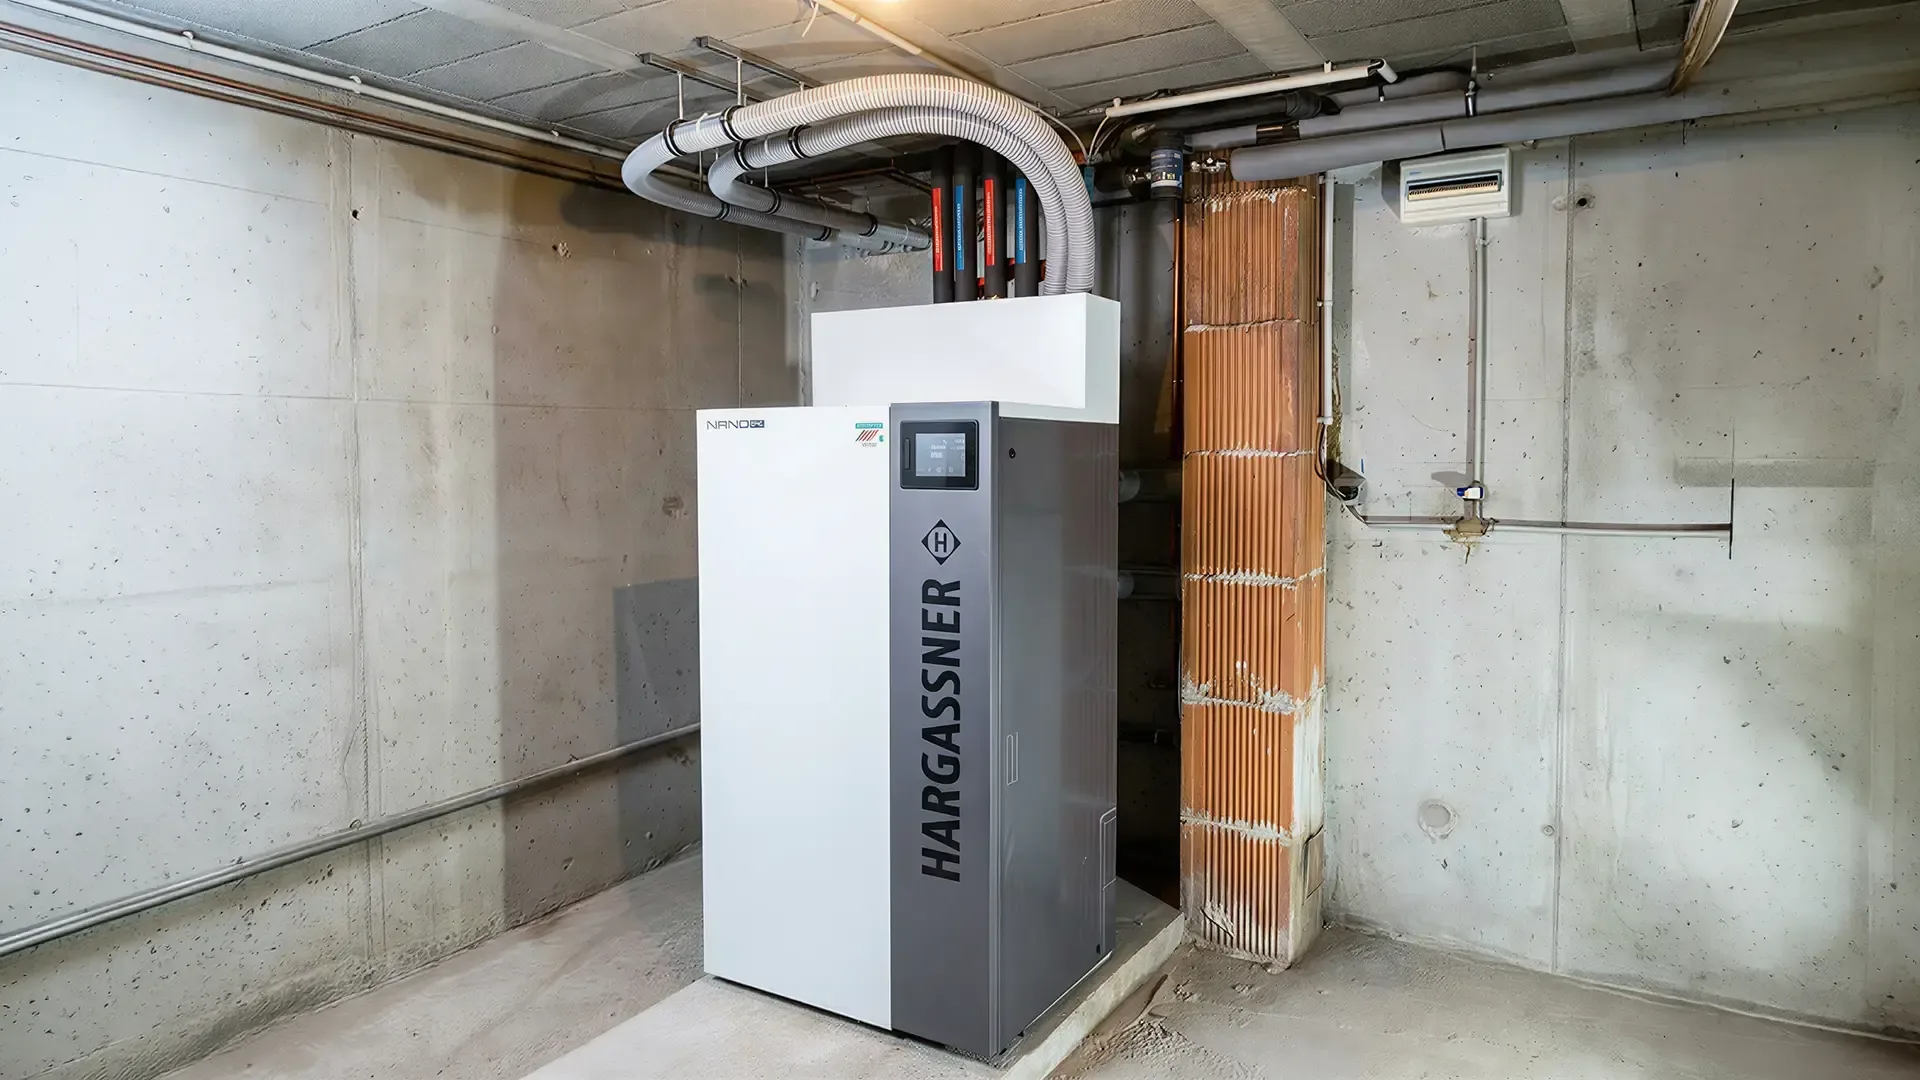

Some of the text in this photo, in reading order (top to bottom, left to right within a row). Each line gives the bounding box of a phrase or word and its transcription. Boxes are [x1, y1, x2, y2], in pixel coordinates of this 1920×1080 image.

[706, 420, 749, 430] NANO
[934, 531, 948, 553] H
[921, 578, 961, 883] HARGASSNER
